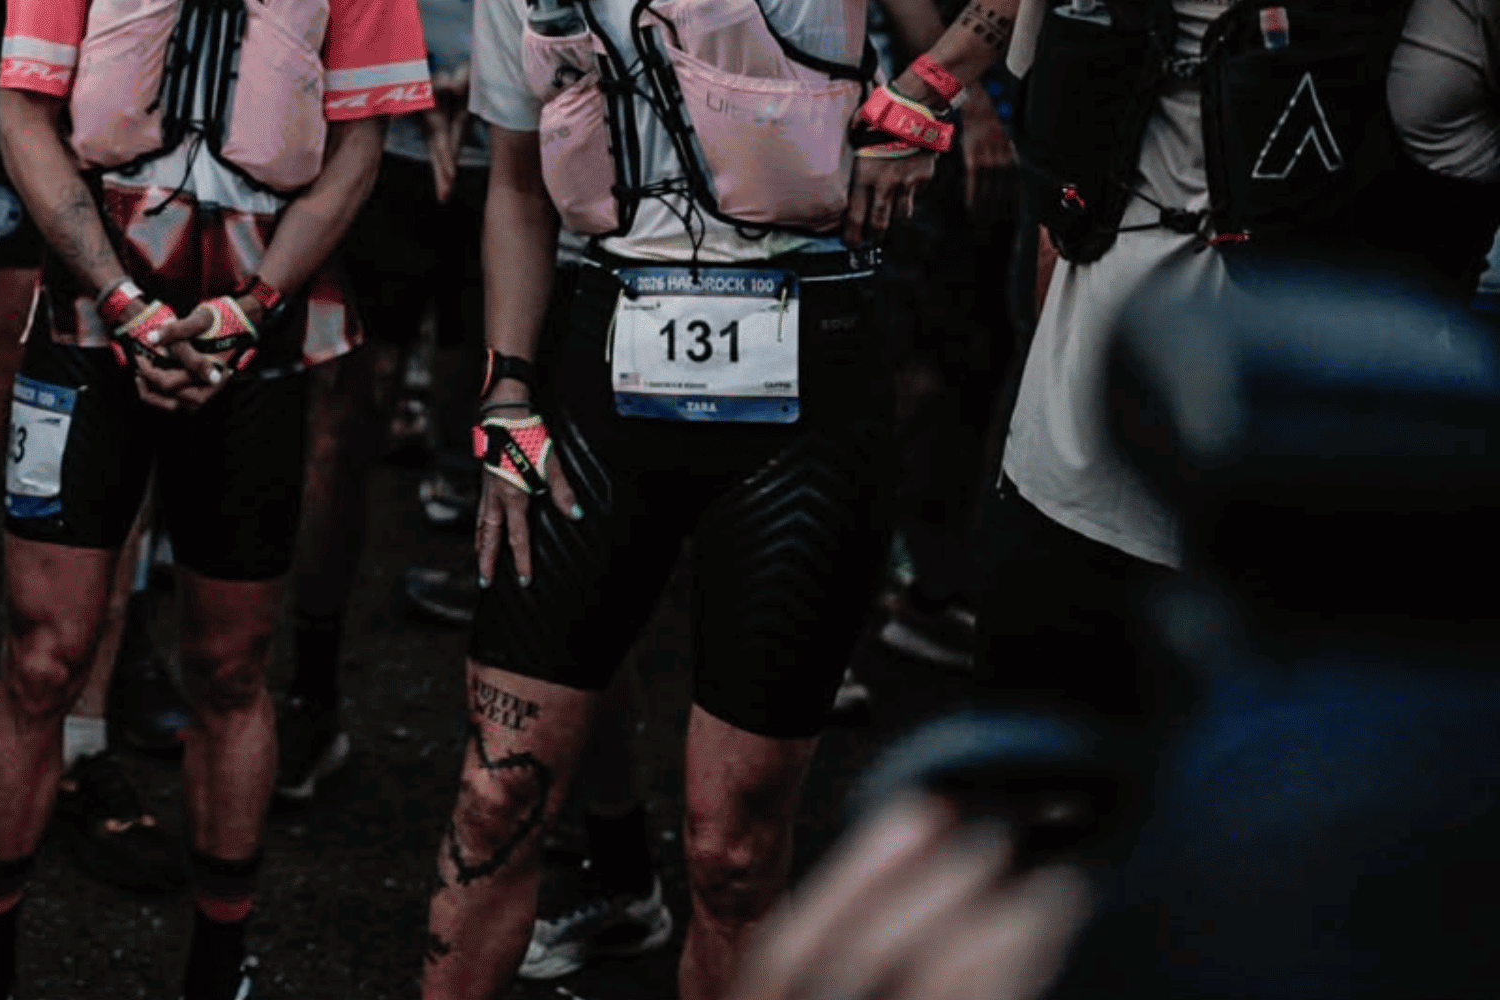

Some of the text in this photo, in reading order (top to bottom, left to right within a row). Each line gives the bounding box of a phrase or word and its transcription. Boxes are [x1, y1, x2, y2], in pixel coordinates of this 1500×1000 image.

[637, 275, 775, 293] 2026 HARDROCK 100
[659, 319, 739, 363] 131
[686, 401, 718, 413] TARA
